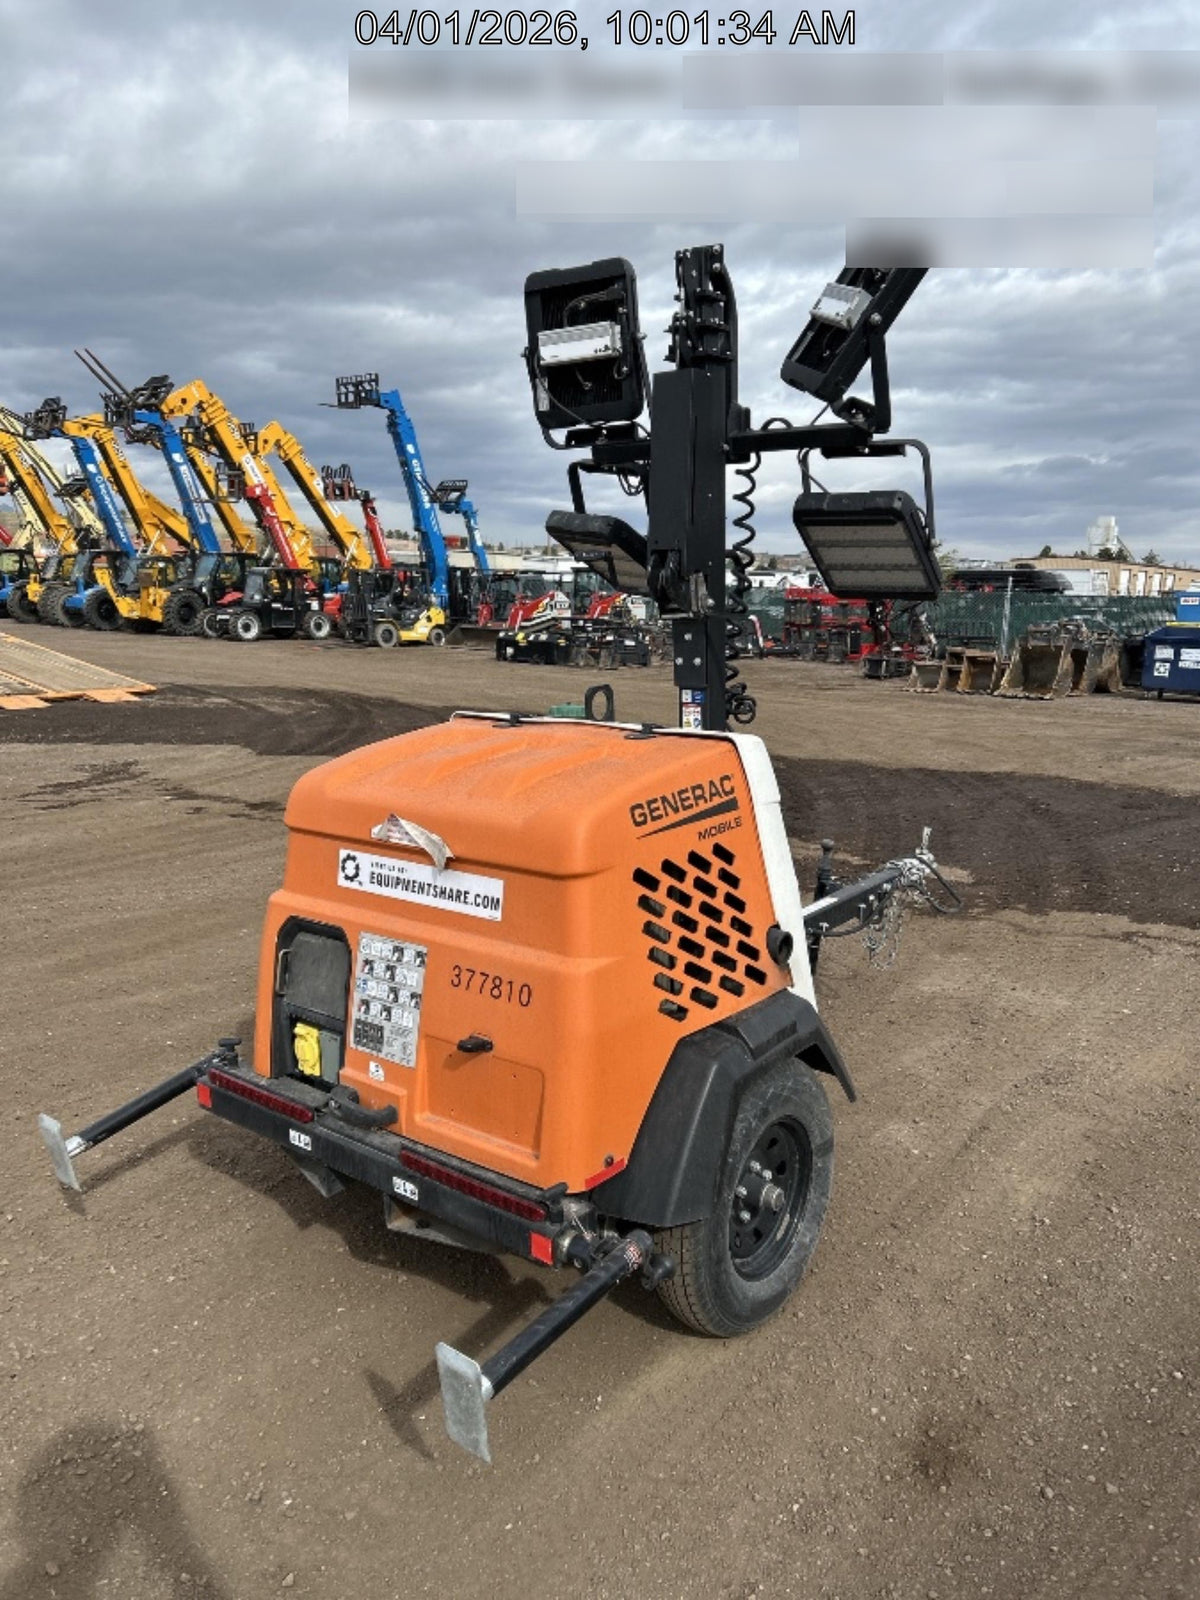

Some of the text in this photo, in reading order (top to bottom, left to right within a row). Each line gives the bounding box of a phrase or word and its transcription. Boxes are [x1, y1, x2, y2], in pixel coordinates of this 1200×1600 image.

[629, 774, 736, 828] GENERAC
[697, 815, 743, 842] MOBILE
[369, 870, 501, 912] EQUIPMENTSHARE.COM
[451, 964, 533, 1008] 377810
